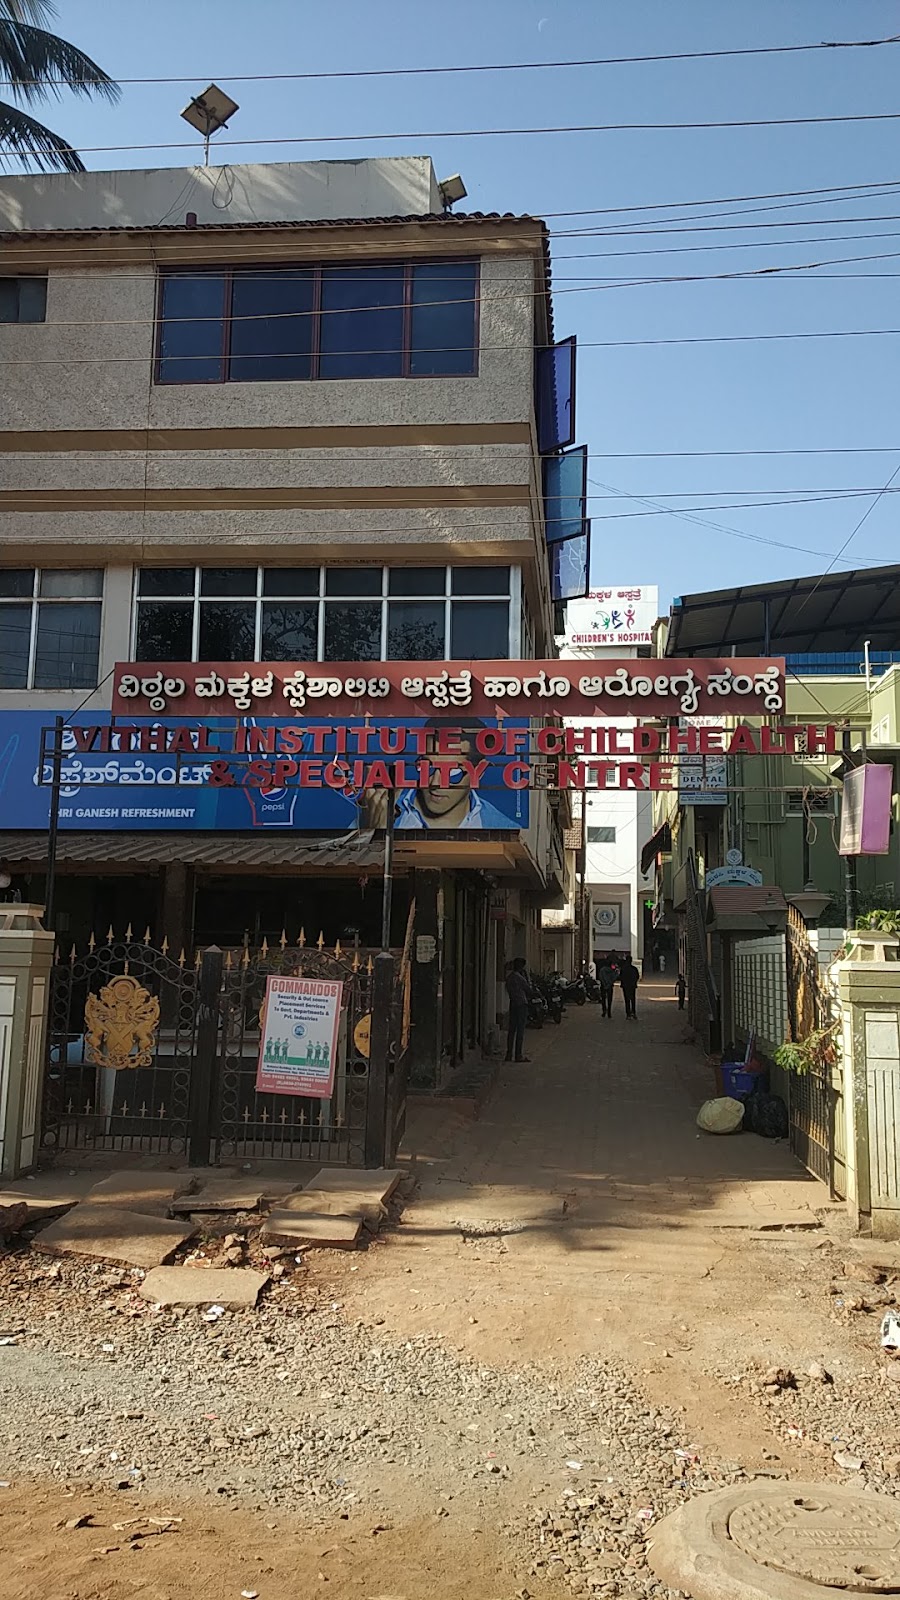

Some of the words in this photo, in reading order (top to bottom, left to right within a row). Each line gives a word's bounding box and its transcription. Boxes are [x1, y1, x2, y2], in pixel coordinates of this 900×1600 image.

[572, 633, 614, 643] CHILDREN'S
[194, 670, 274, 710] ಮಕ್ಕಳ
[401, 670, 473, 708] ಆಸ್ಪತ್ರೆ
[483, 669, 571, 698] ಹಾಗೂ
[578, 668, 702, 713] ಆರೋಗ್ಯ
[707, 666, 783, 713] ಸಂಸ್ಥೆ
[72, 726, 219, 752] VITHAL
[236, 726, 461, 755] INSTITUTE
[475, 726, 527, 755] OF
[536, 726, 661, 755] CHILD
[668, 725, 836, 755] HEALTH
[208, 759, 237, 788] &
[248, 759, 490, 788] SPECIALITY
[75, 808, 119, 818] GANESH
[121, 808, 195, 818] REFRESHMENT
[261, 803, 286, 813] pepsi
[271, 980, 337, 997] COMMANDOS
[294, 1008, 324, 1016] Departments
